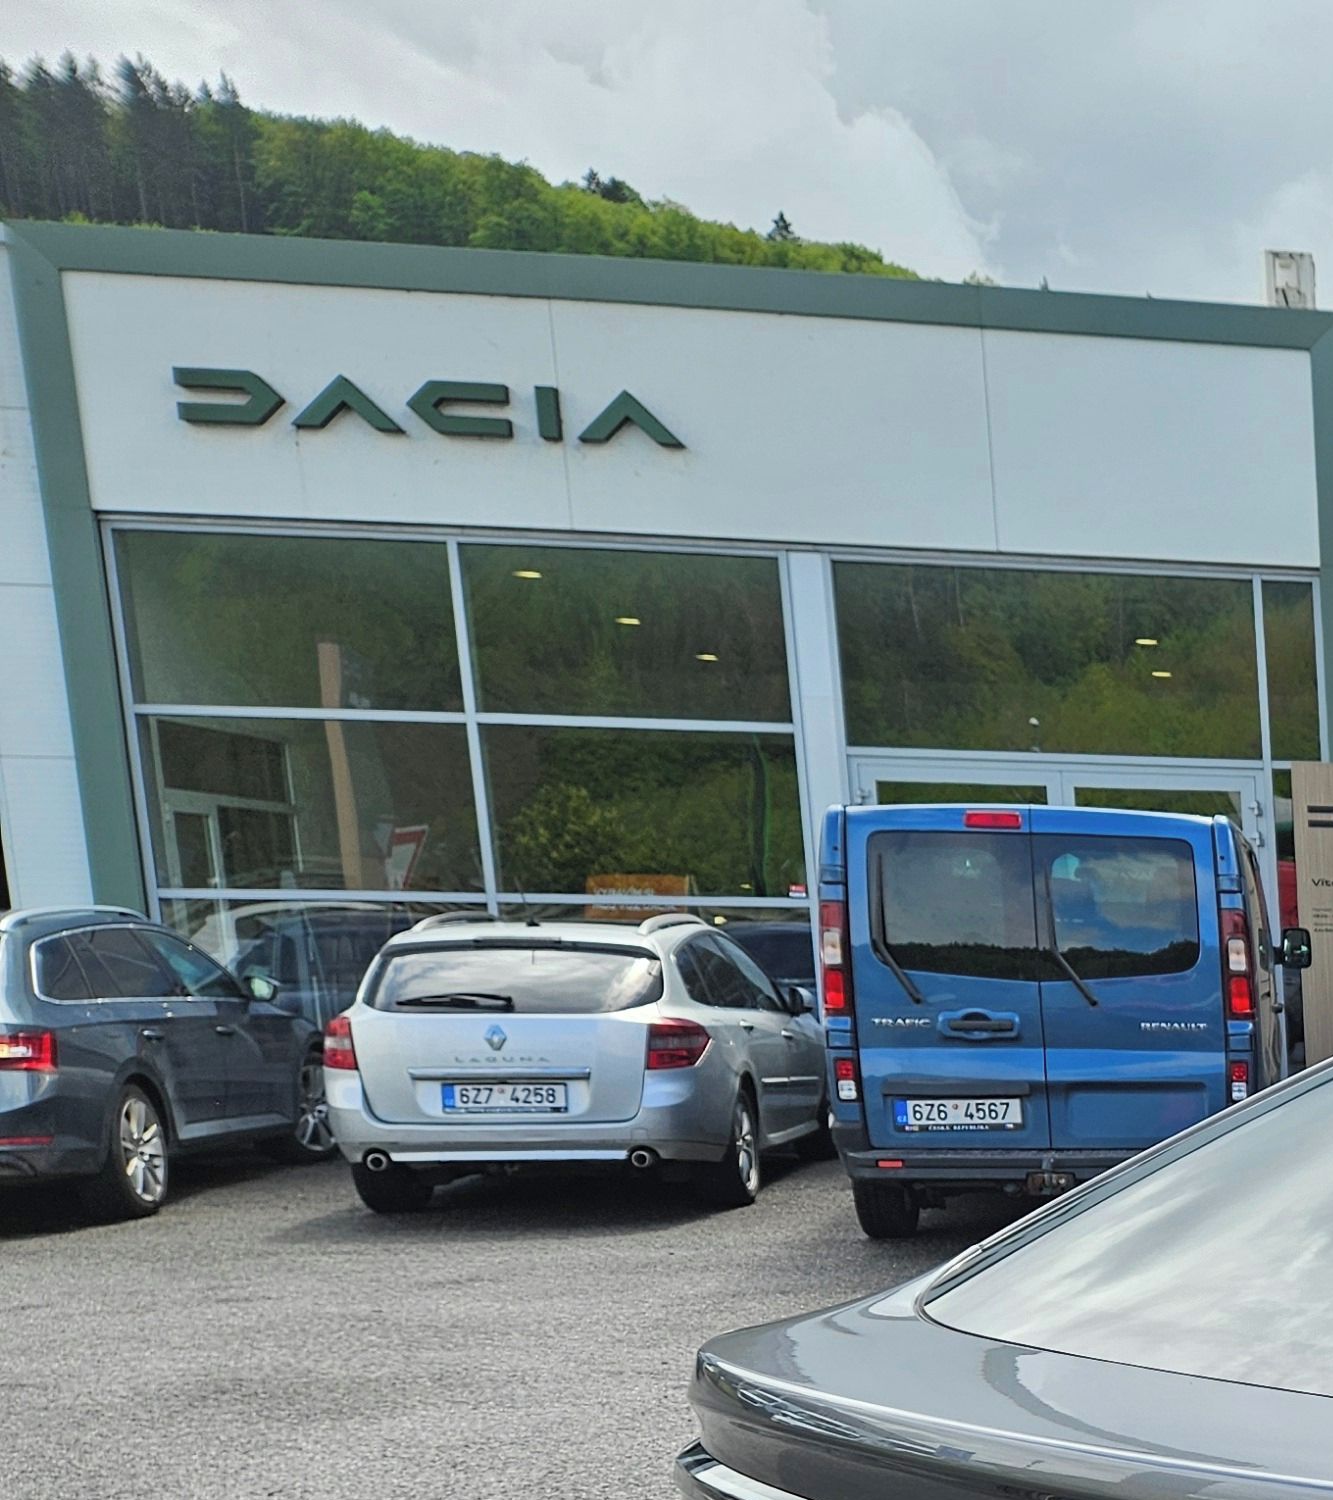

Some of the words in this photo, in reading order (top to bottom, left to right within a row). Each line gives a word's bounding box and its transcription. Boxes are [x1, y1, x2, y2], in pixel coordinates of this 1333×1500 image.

[171, 365, 688, 449] DACIA
[872, 1017, 931, 1028] TRAFIC
[1140, 1022, 1207, 1031] RENAULT
[454, 1055, 550, 1064] LAGUNA
[459, 1087, 493, 1104] 6Z7
[510, 1087, 556, 1104] 4258
[912, 1103, 948, 1121] 6Z6
[964, 1102, 1010, 1120] 4567
